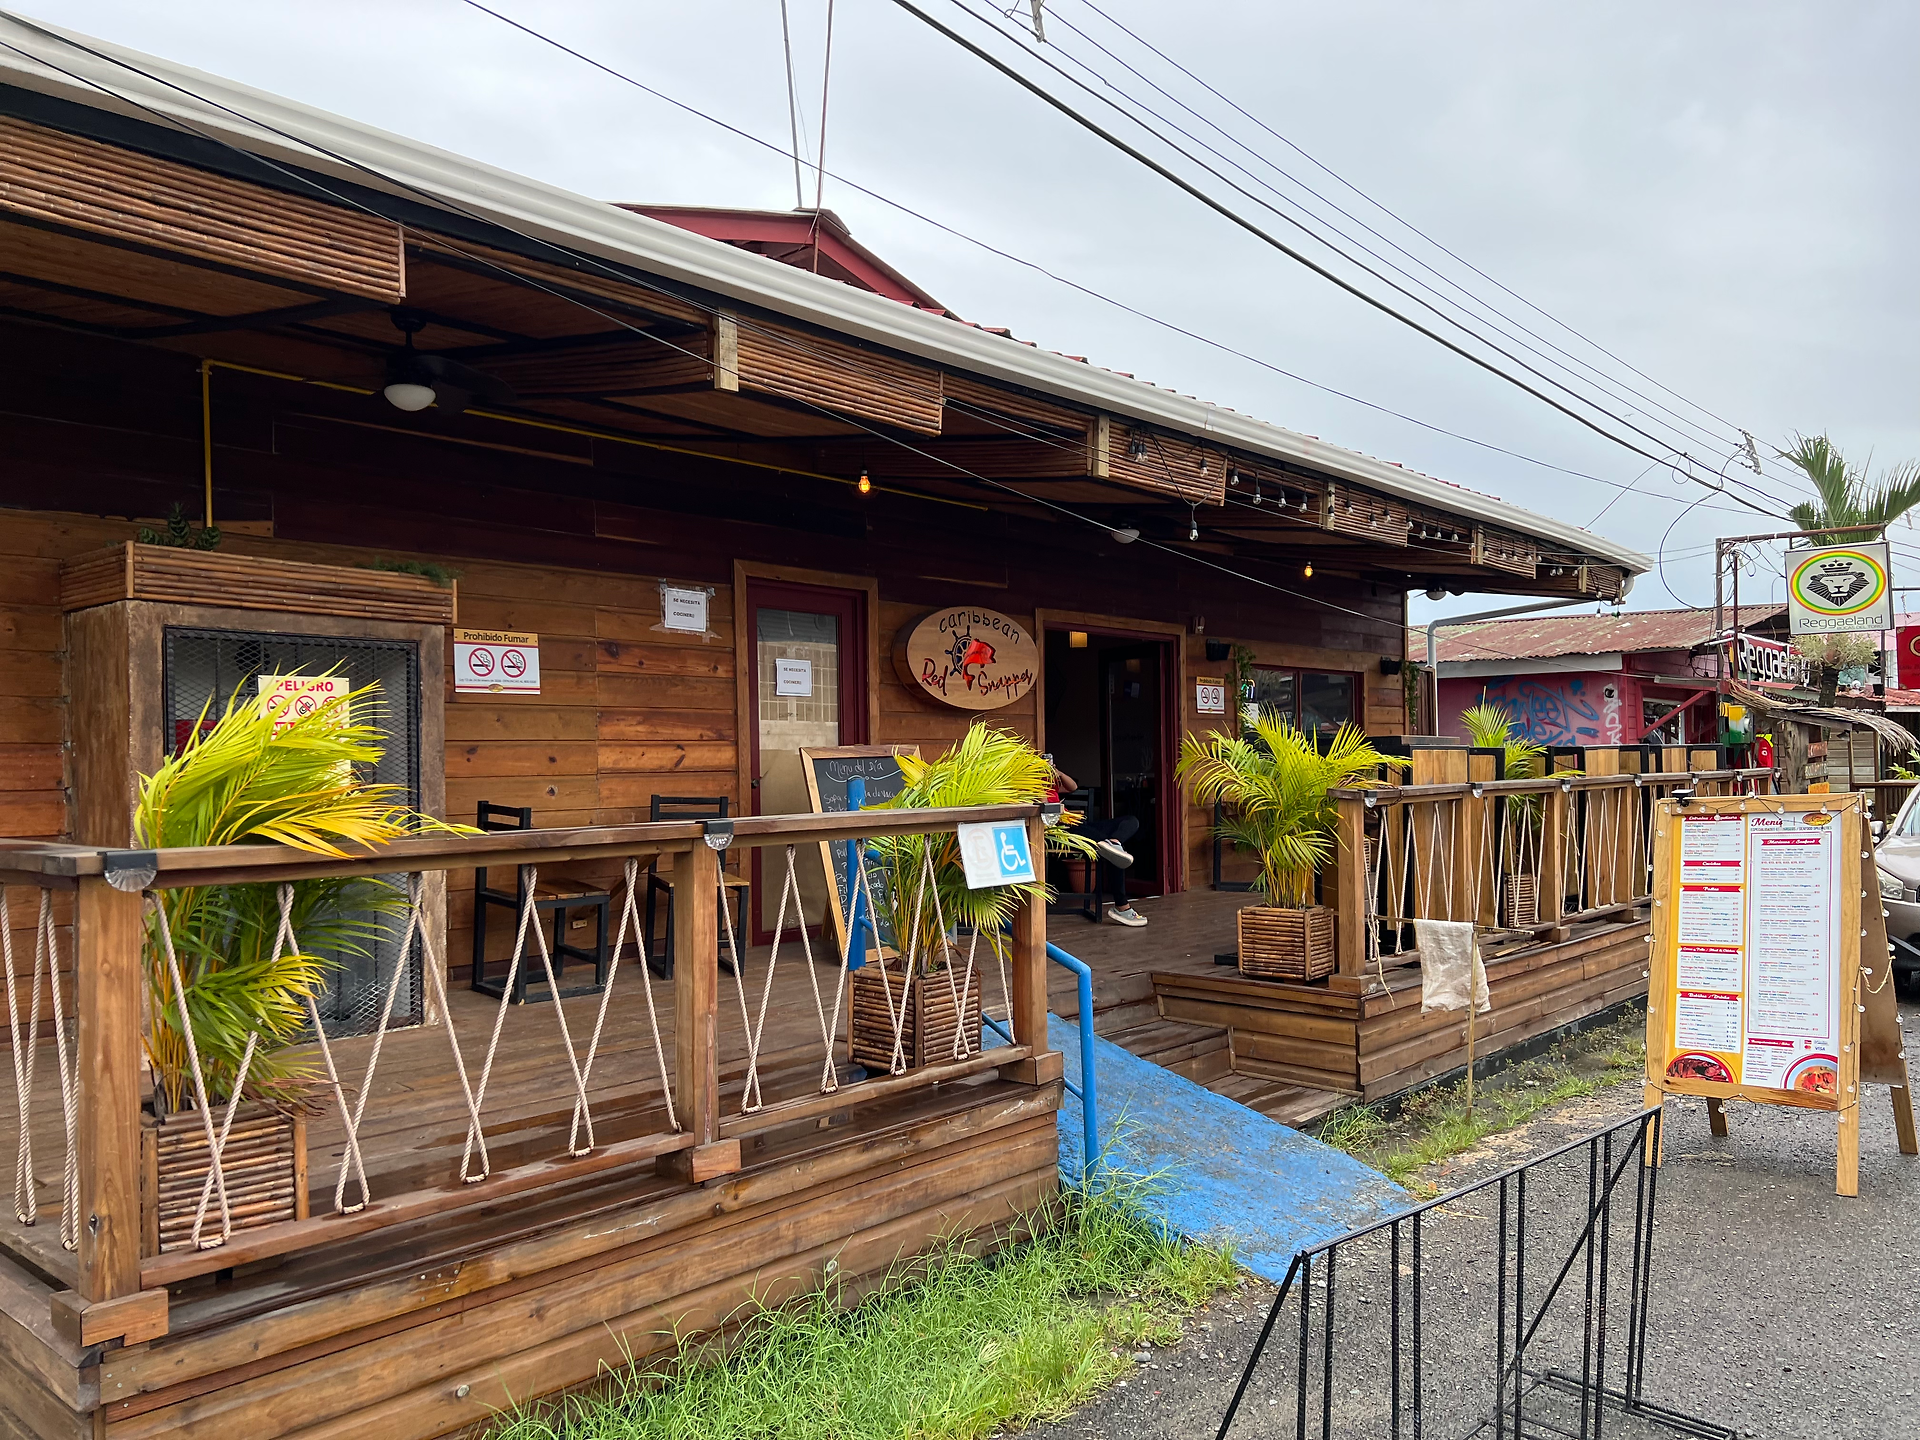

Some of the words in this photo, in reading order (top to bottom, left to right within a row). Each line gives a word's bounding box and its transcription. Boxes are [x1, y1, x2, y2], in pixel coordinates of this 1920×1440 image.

[1799, 614, 1883, 629] Reggaeland
[463, 632, 502, 641] Prohibido
[504, 635, 529, 643] Fumar
[921, 658, 949, 697] Red
[977, 668, 1033, 700] Snapper
